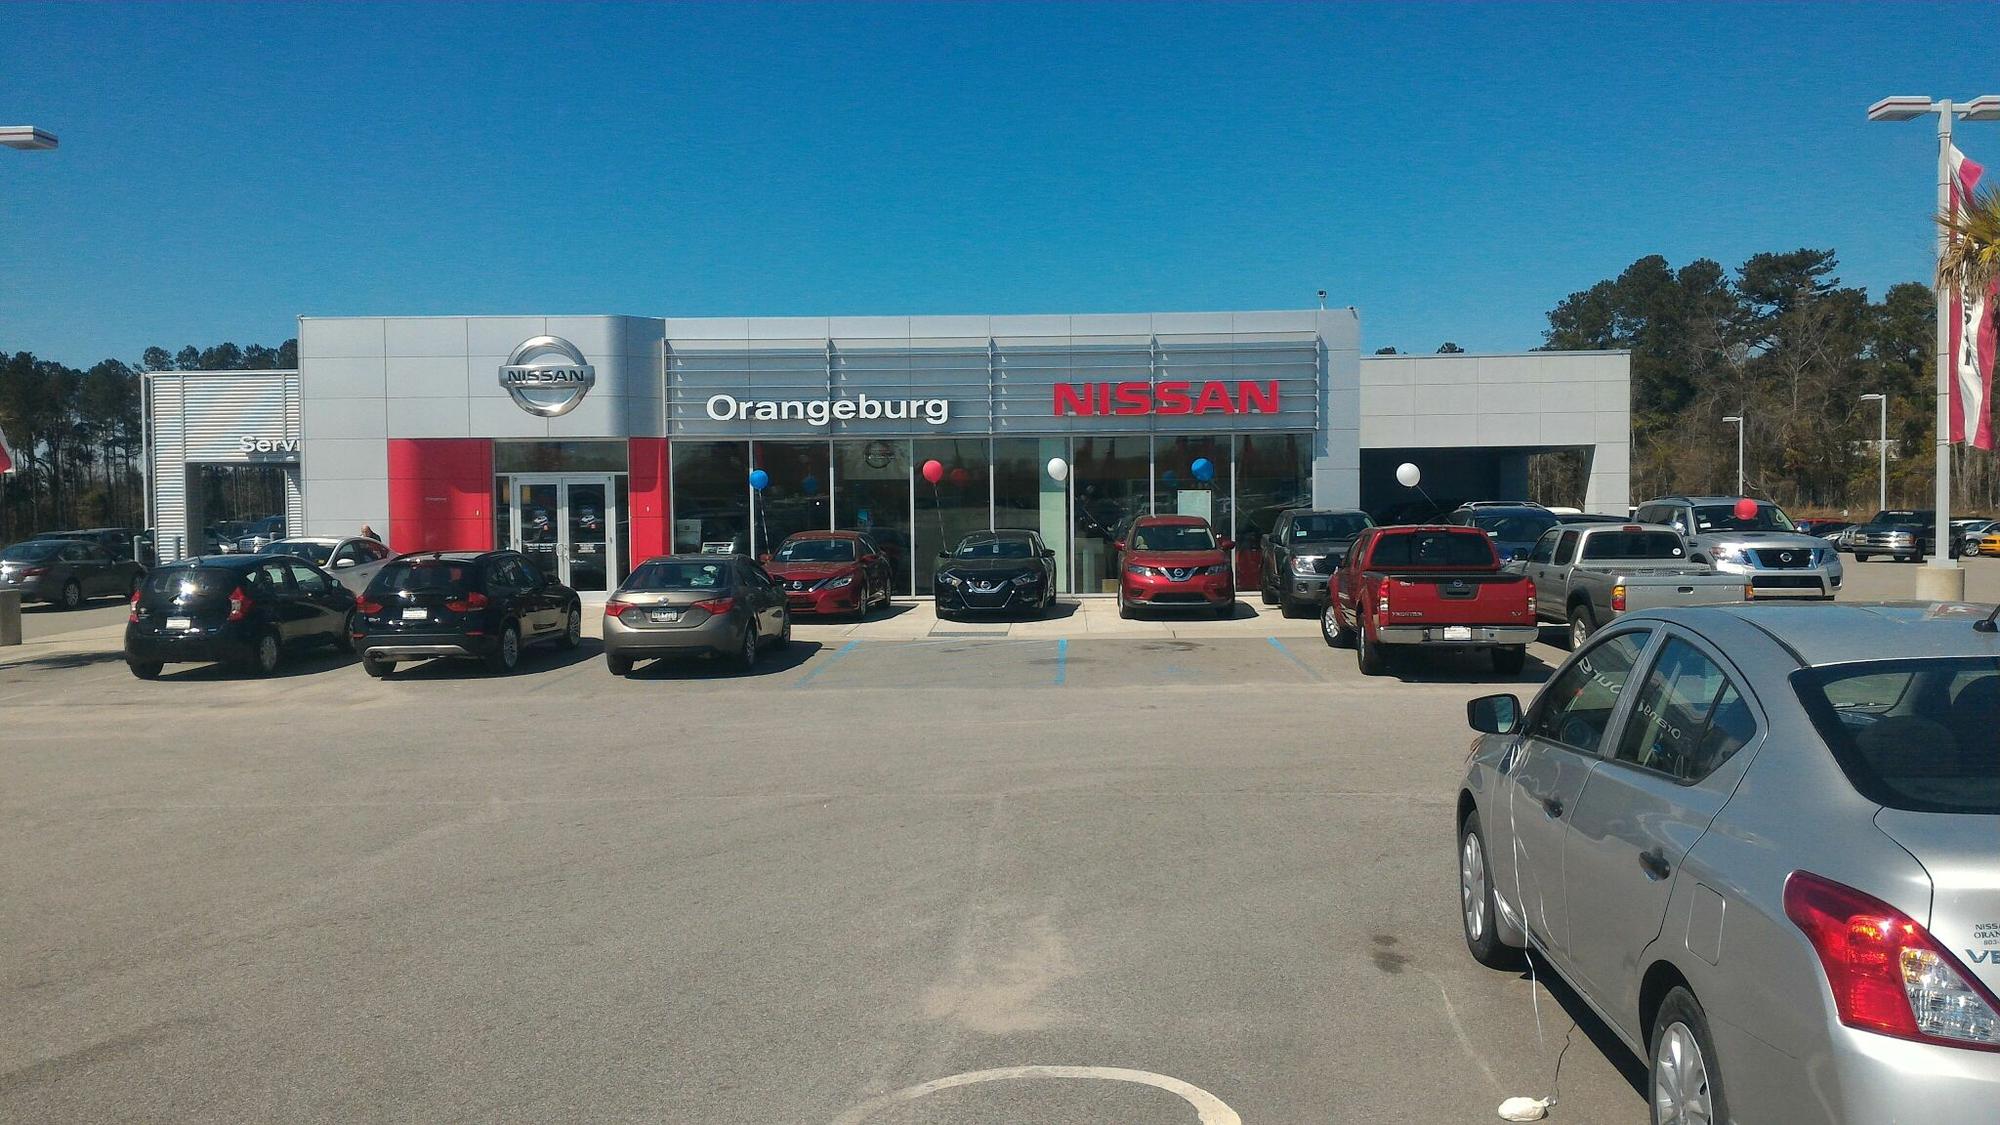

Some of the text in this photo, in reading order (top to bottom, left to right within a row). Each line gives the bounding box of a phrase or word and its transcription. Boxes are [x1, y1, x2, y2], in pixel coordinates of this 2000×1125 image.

[507, 370, 584, 382] NISSAN
[706, 393, 949, 426] Orangeburg
[1053, 379, 1280, 416] NISSAN
